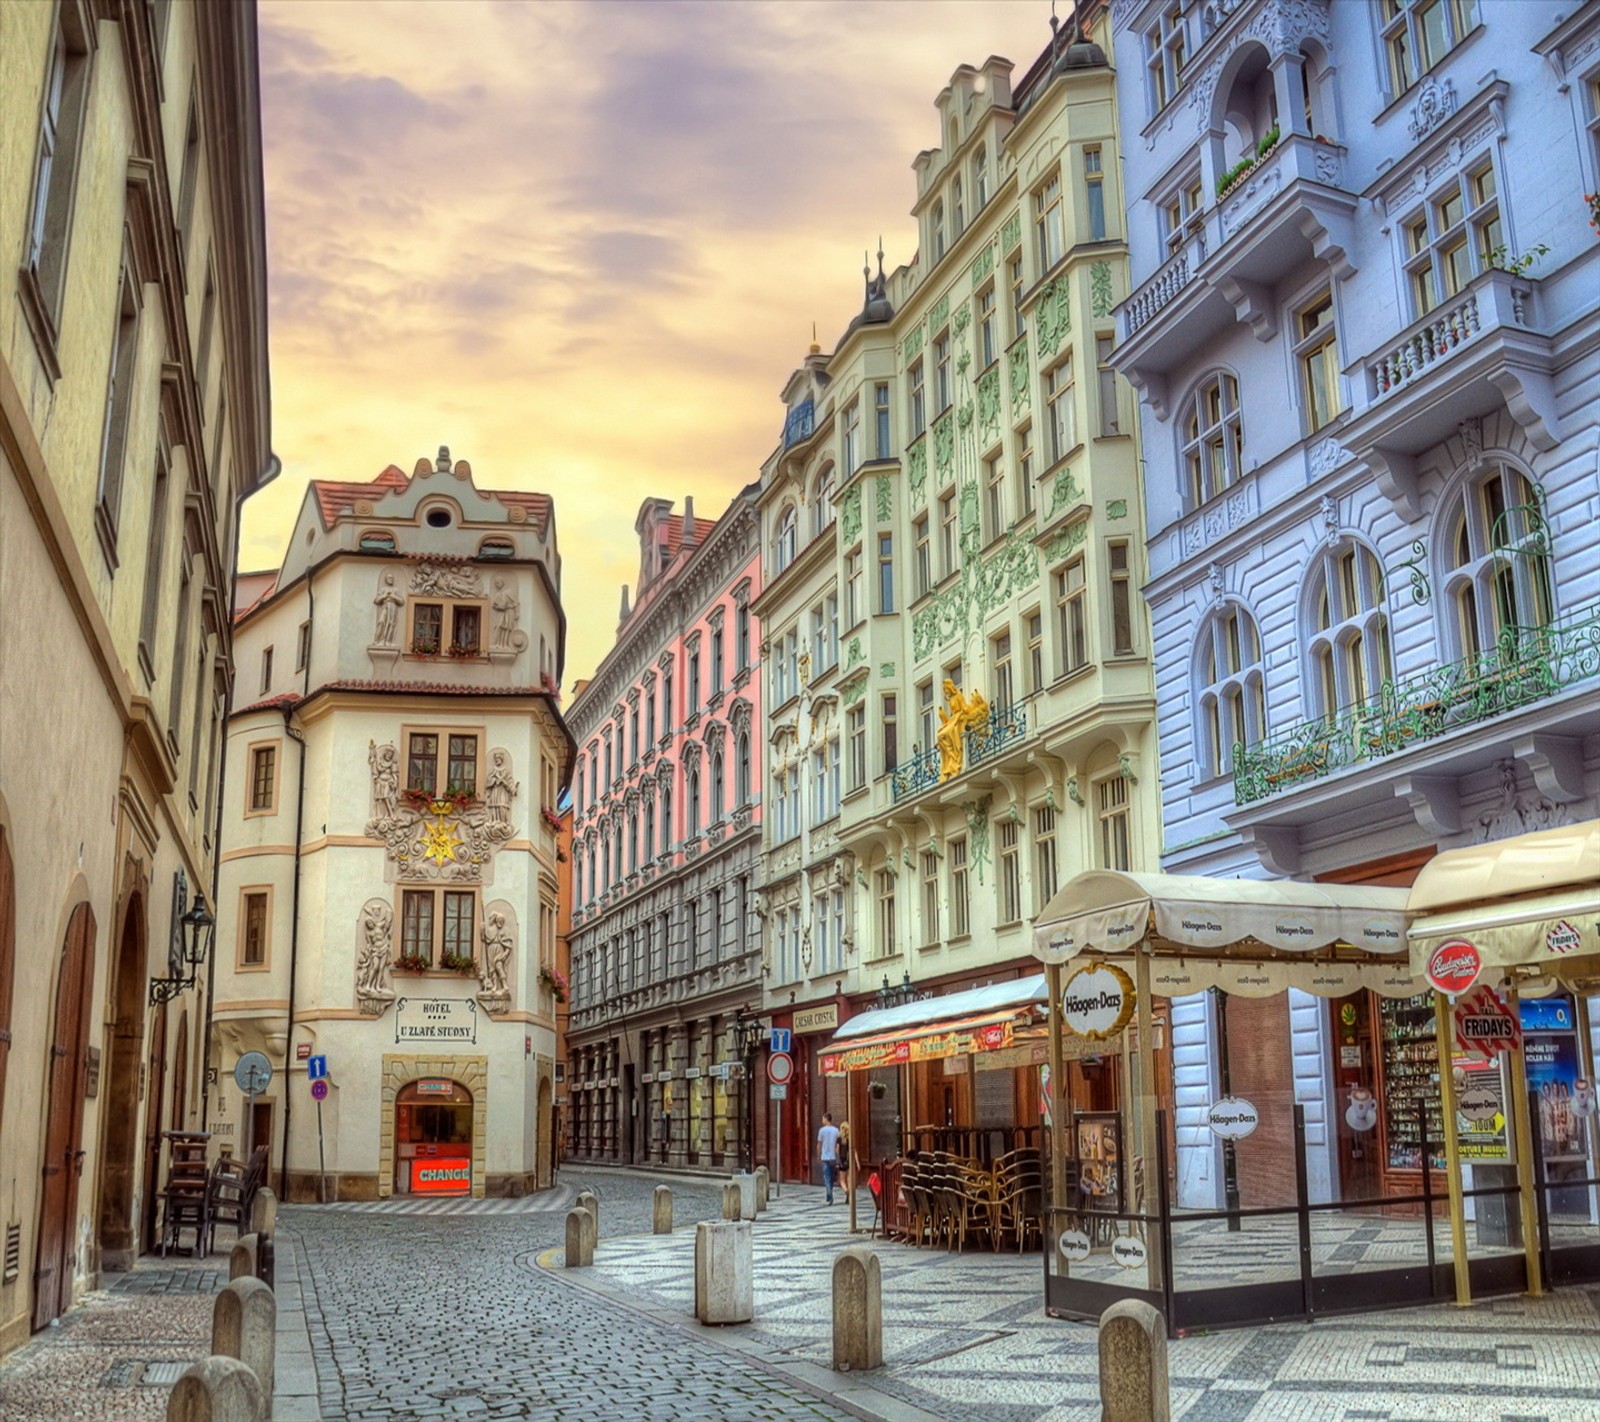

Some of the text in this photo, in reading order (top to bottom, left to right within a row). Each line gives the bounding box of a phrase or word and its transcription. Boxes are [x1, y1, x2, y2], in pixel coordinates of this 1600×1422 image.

[1182, 921, 1222, 931] Häagen-Dazs
[1276, 926, 1314, 936] Häagen-Dazs
[1363, 929, 1399, 939] Häagen-Dazs
[423, 1003, 451, 1013] HOTEL
[1065, 991, 1121, 1016] Häagen-Dazs
[815, 1011, 835, 1025] CRYSTAL
[401, 1026, 407, 1036] U
[409, 1025, 435, 1036] ZLATÉ
[1209, 1113, 1256, 1126] Häagen-Dazs
[420, 1169, 470, 1181] CHANGE
